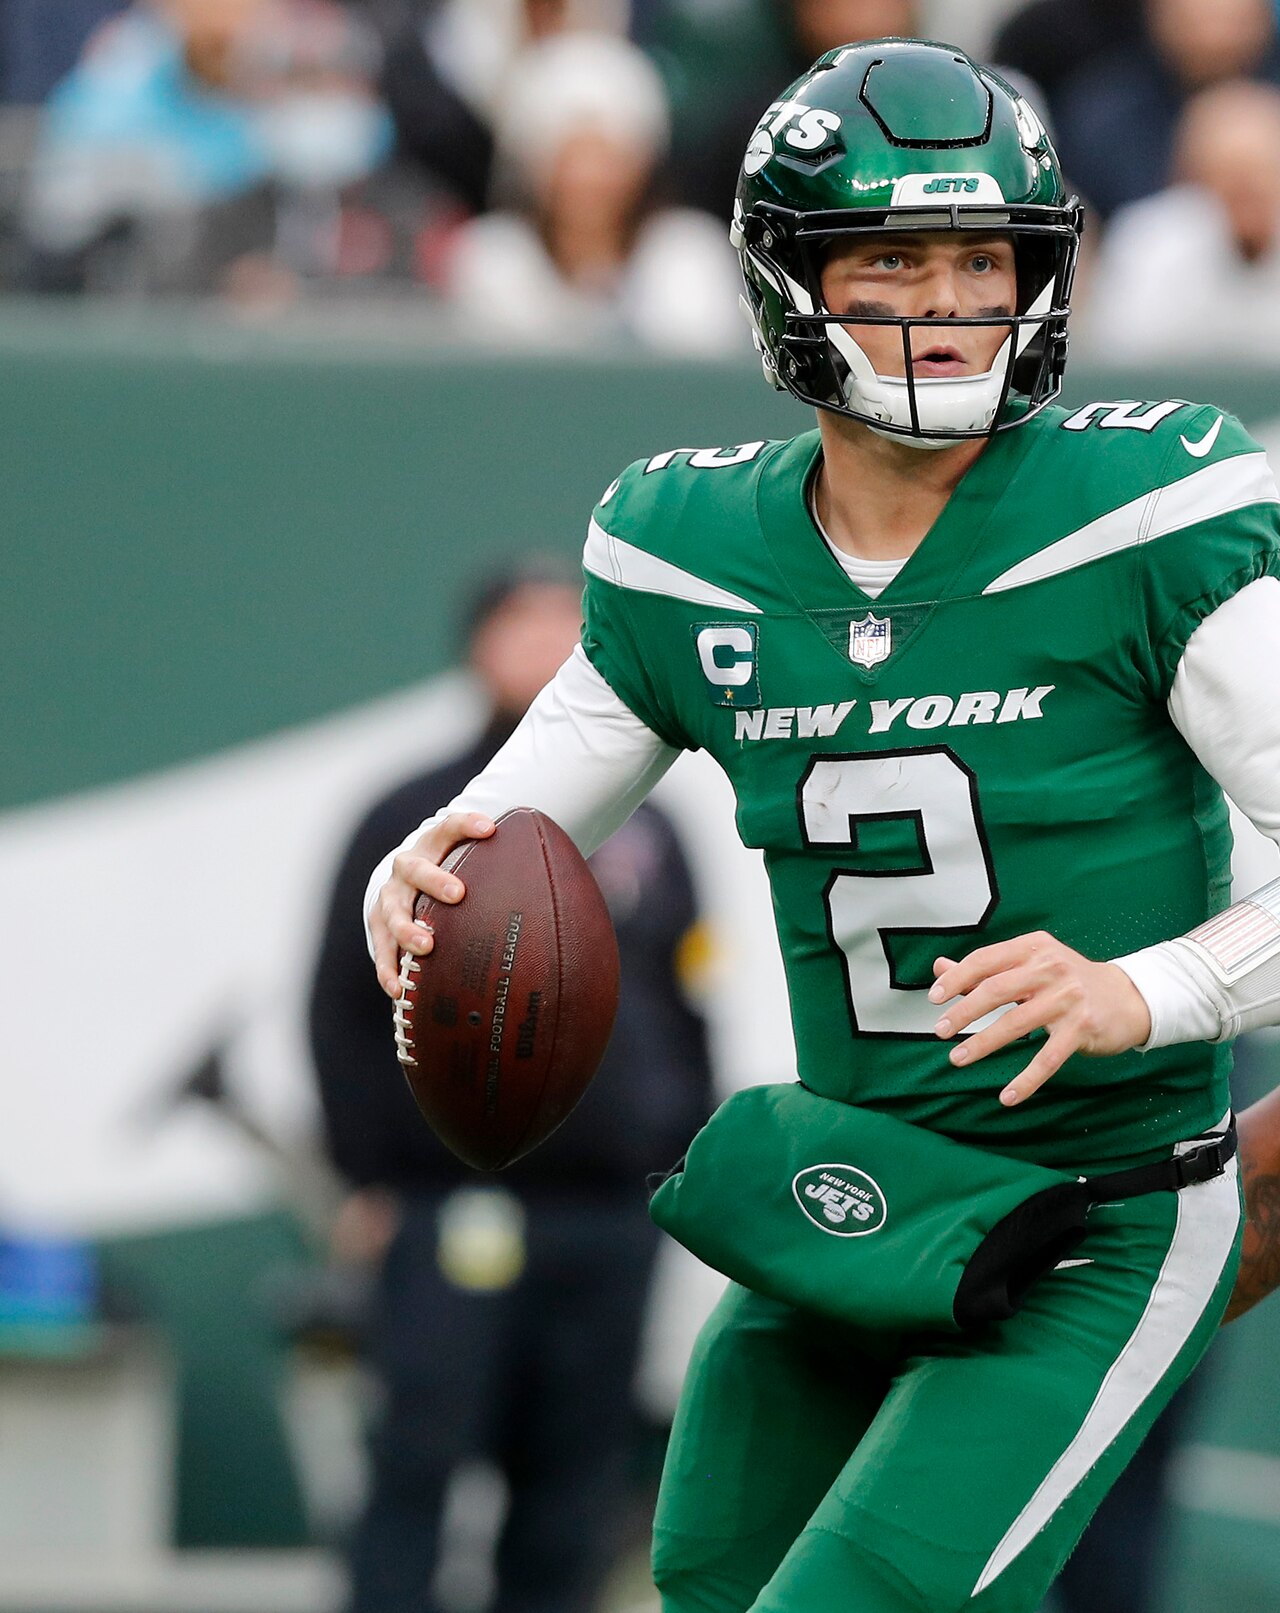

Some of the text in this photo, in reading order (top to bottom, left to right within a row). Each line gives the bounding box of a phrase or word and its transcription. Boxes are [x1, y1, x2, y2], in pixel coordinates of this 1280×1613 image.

[923, 178, 979, 194] JETS
[1061, 399, 1189, 433] 2
[697, 627, 753, 686] C
[855, 637, 883, 658] NFL
[735, 684, 1056, 742] NEW YORK
[796, 744, 1000, 1041] 2
[489, 977, 511, 1052] FOOTBALL
[501, 911, 523, 971] LEAGUE
[804, 1183, 875, 1221] JETS
[819, 1172, 874, 1202] NEW YORK
